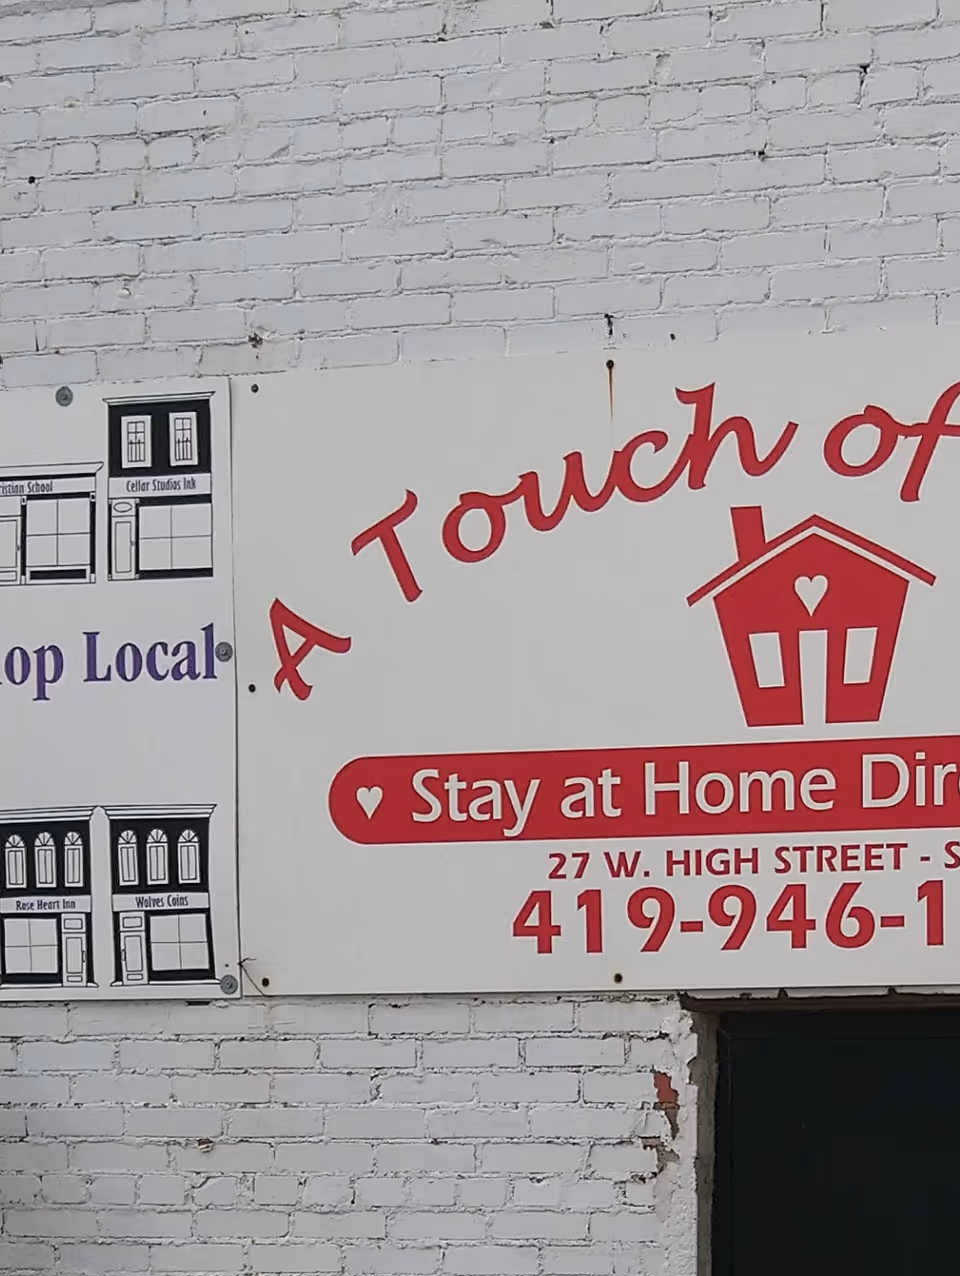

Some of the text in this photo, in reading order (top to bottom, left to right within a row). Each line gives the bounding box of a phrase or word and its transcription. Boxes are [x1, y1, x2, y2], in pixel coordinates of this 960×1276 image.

[27, 480, 54, 494] School
[126, 476, 196, 493] Cellar Studios Ink
[268, 598, 352, 701] A
[350, 382, 799, 603] Touch
[0, 622, 218, 701] op Local
[413, 769, 540, 836] Stay
[561, 769, 621, 818] at
[645, 762, 835, 814] Home
[548, 852, 589, 879] 27
[603, 851, 650, 879] W.
[666, 848, 759, 876] HIGH
[775, 843, 907, 874] STREET
[16, 899, 35, 911] Rose
[62, 898, 76, 910] Inn
[167, 893, 189, 908] Coins
